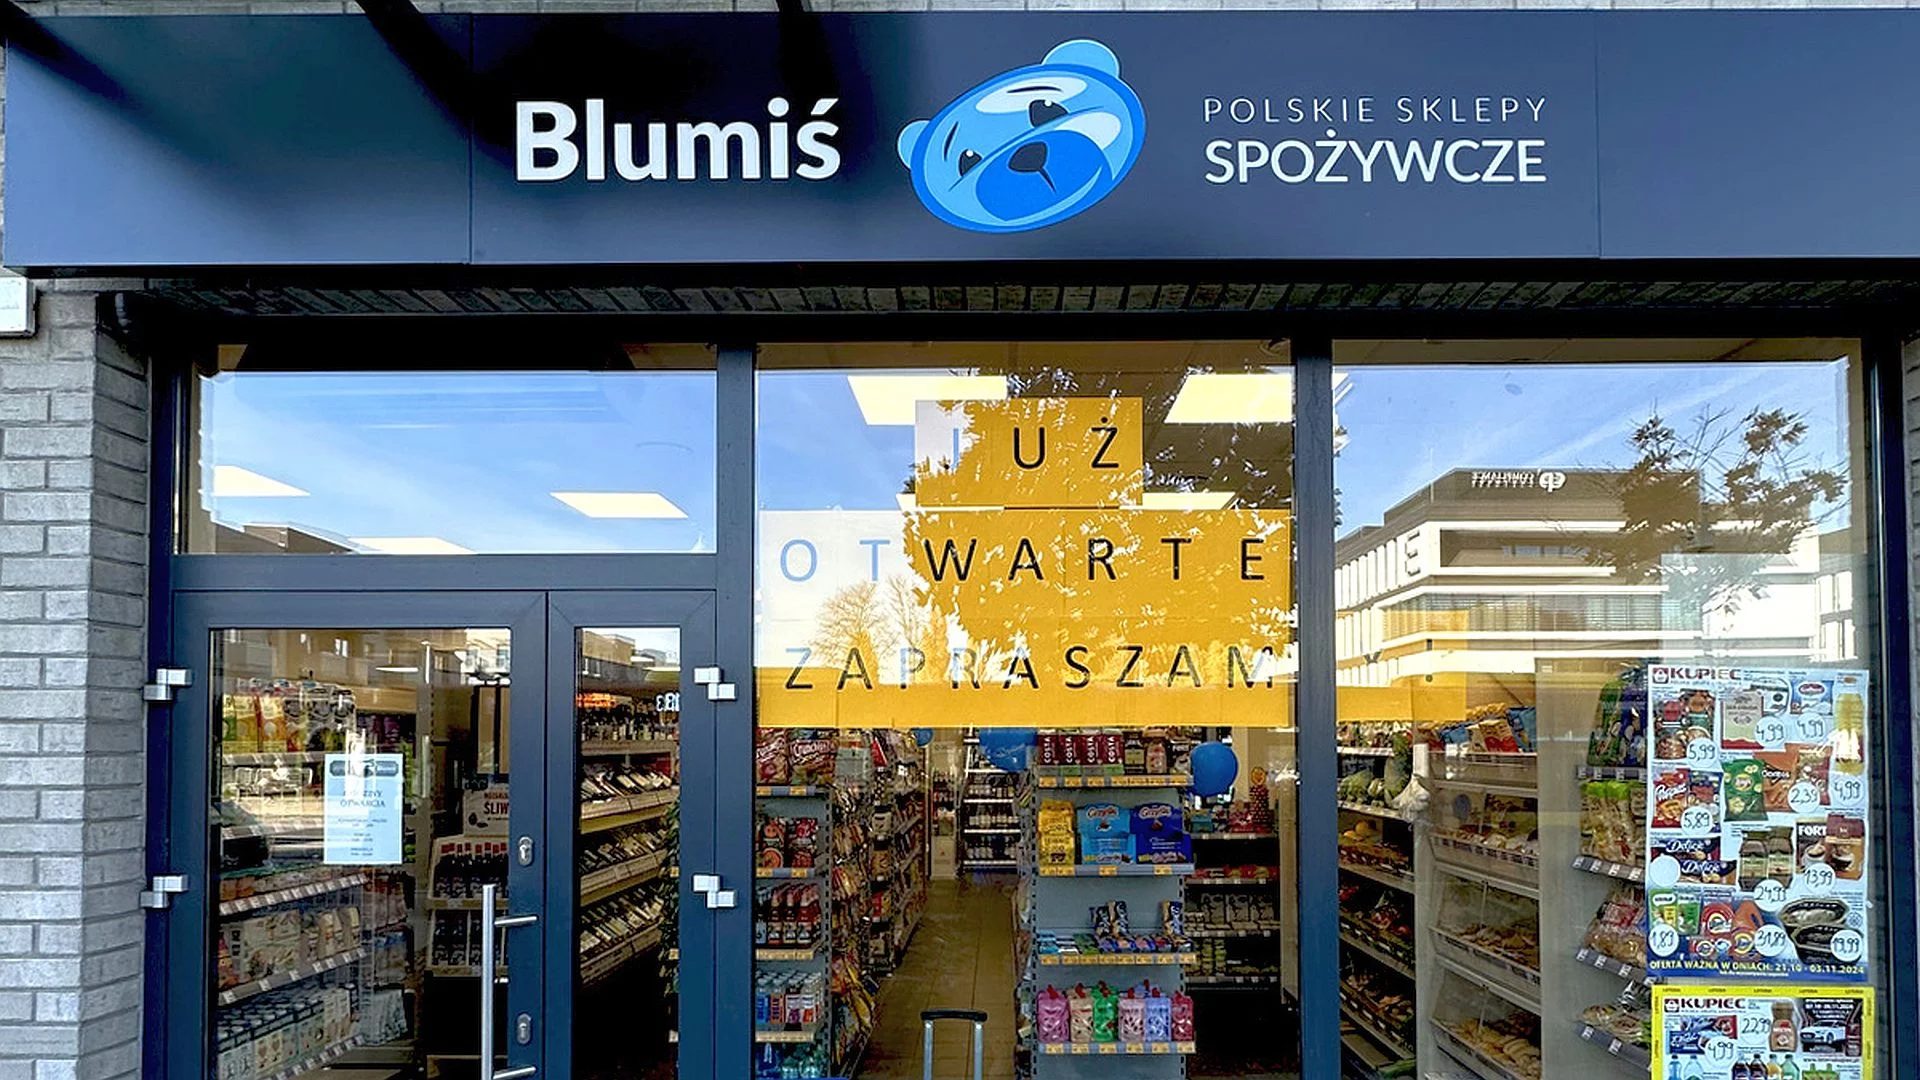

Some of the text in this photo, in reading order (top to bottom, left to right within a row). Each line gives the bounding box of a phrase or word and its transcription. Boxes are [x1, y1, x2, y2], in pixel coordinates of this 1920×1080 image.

[1205, 98, 1544, 122] POLSKIE SKLEPY
[517, 98, 840, 180] Blumiś
[1206, 130, 1546, 182] SPOŻYWCZE
[779, 537, 1264, 581] OTWARTE
[785, 646, 1273, 690] ZAPRASZAM
[1670, 667, 1742, 680] KUPIEC
[1044, 736, 1052, 763] COSTA
[1065, 736, 1073, 763] COSTA
[1087, 736, 1095, 763] COSTA
[1107, 736, 1116, 762] COSTA
[1681, 998, 1745, 1009] KUPIEC
